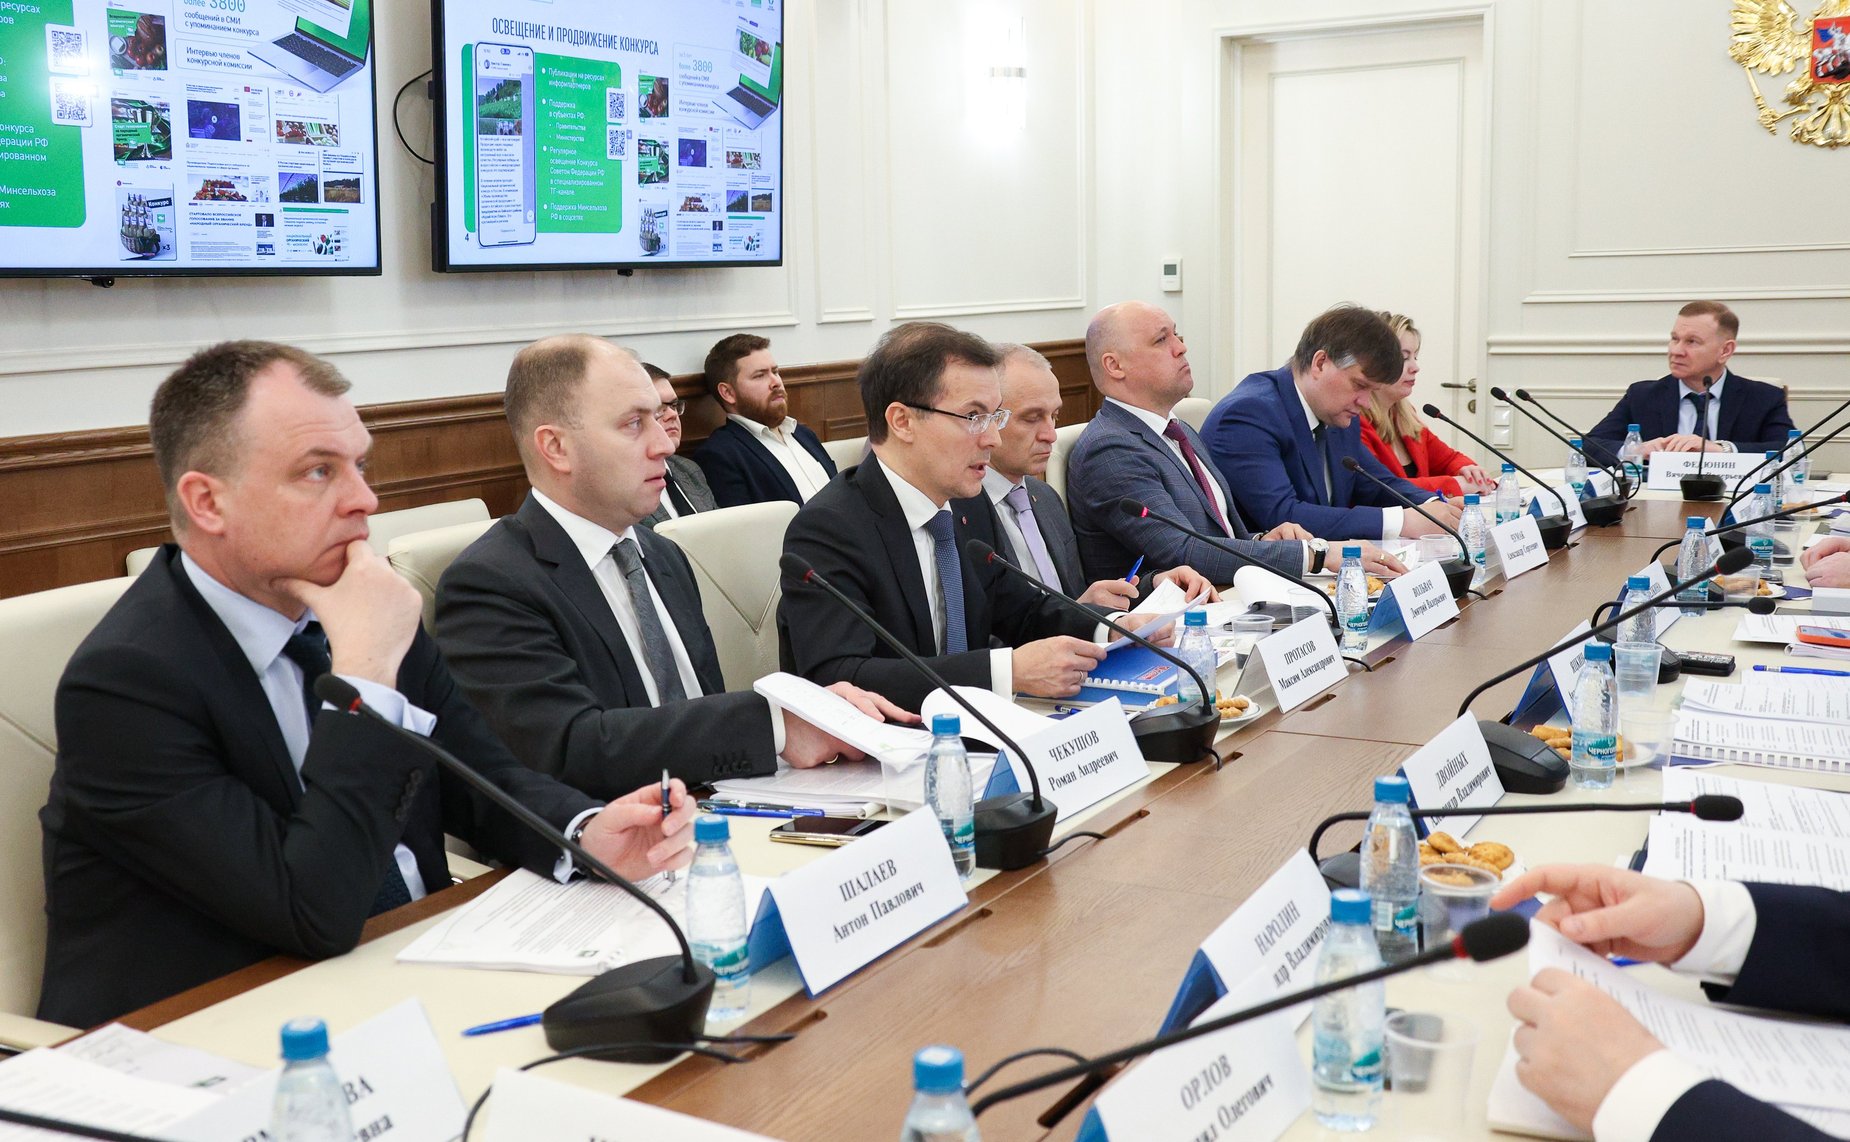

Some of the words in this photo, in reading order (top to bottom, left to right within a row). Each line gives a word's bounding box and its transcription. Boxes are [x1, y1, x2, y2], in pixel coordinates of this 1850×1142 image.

[1, 2, 41, 14] ресурсах
[185, 11, 220, 22] сообщений
[226, 15, 241, 25] СМИ
[190, 21, 232, 32] упоминанием
[232, 28, 260, 36] конкурса
[492, 17, 546, 40] ОСВЕЩЕНИЕ
[548, 26, 554, 41] И
[556, 26, 618, 50] ПРОДВИЖЕНИЕ
[619, 36, 659, 56] КОНКУРСА
[186, 46, 218, 58] Интервью
[219, 52, 240, 60] членов
[186, 58, 222, 67] конкурсной
[223, 62, 253, 70] комиссии
[692, 59, 713, 73] 3800
[0, 124, 35, 134] онкурса
[0, 137, 33, 148] ерации
[35, 138, 49, 148] РФ
[0, 151, 47, 162] ированном
[0, 186, 57, 197] Минсельхоза
[464, 233, 470, 242] 4
[1410, 601, 1428, 619] Дмитрий
[1283, 639, 1317, 666] ПРОТАСОВ
[1277, 672, 1301, 691] Максим
[1299, 654, 1336, 680] Александрович
[1048, 729, 1100, 763] ЧЕКУШОВ
[1047, 770, 1078, 792] Роман
[1077, 750, 1120, 778] Андреевич
[1435, 750, 1469, 791] ДВОЙНЫХ
[1455, 765, 1492, 803] Владимирович
[838, 858, 898, 903] ШАЛАЕВ
[832, 912, 870, 944] Антон
[869, 881, 926, 921] Павлович
[1284, 915, 1333, 971] Владимиров
[1180, 1053, 1232, 1112] ОРЛОВ
[1216, 1073, 1275, 1130] Олегович
